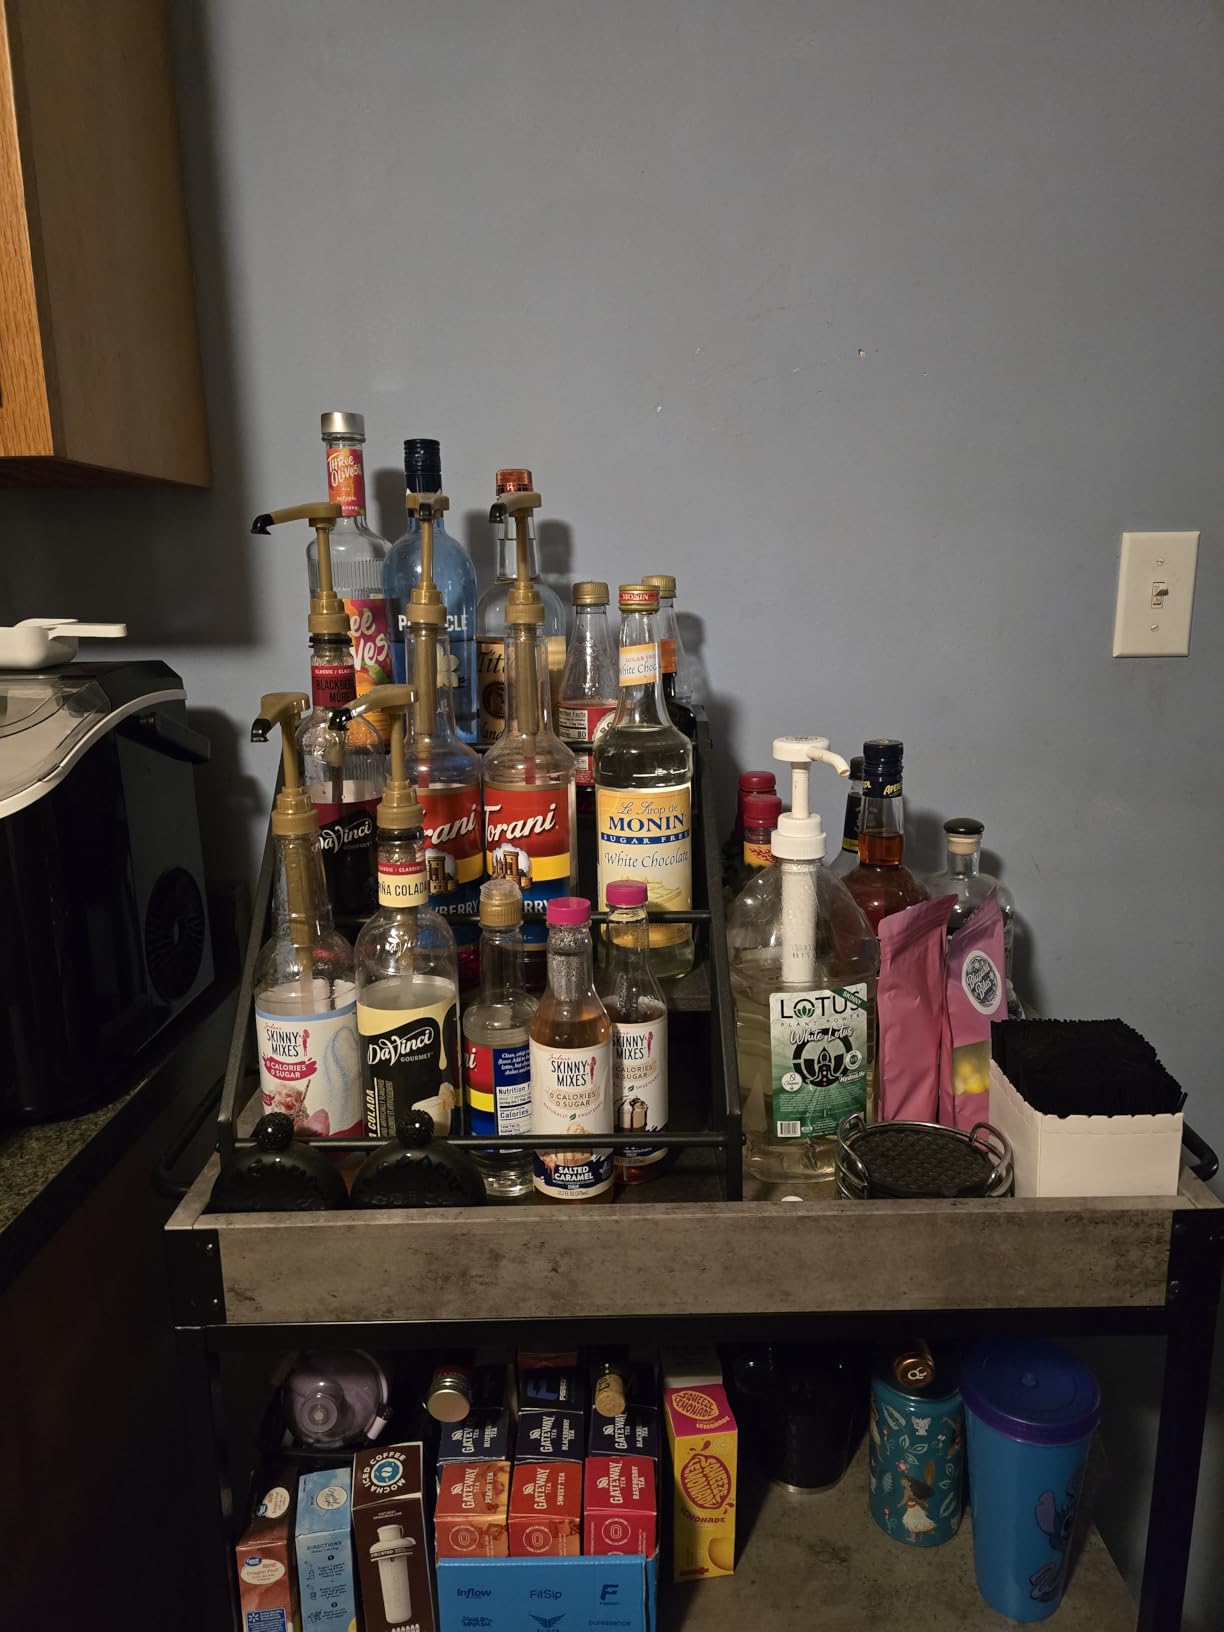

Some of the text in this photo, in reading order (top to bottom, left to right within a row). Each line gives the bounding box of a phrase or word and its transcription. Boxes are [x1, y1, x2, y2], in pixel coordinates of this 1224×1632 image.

[398, 614, 468, 632] PCLE
[477, 649, 504, 675] Tit
[637, 660, 657, 673] Choc
[883, 781, 904, 796] APER
[617, 801, 678, 816] Le Sirop de
[424, 803, 477, 845] rani
[484, 803, 557, 845] Torani
[608, 813, 686, 832] MONIN
[603, 831, 689, 844] SUGAR FREE
[605, 848, 688, 868] White Chocolate
[378, 877, 427, 897] IÑA COLADA
[435, 900, 480, 915] BERRY
[780, 990, 861, 1019] LOTUS
[842, 990, 863, 1005] SKINNY
[826, 1014, 860, 1024] POWER
[266, 1029, 299, 1045] SKINNY
[612, 1035, 645, 1048] SKINNY
[790, 1026, 854, 1045] White Lotus
[271, 1043, 299, 1057] MIXES
[367, 1026, 434, 1066] DaVinci
[616, 1047, 644, 1060] MIXES
[400, 1053, 431, 1063] GOURMET
[270, 1062, 307, 1071] CALORIES
[275, 1070, 301, 1078] SUGAR
[551, 1060, 587, 1074] SKINNY
[615, 1064, 653, 1073] CALORIES
[556, 1074, 587, 1087] MIXES
[621, 1072, 648, 1080] SUGAR
[498, 1086, 526, 1096] Nutrition
[556, 1092, 596, 1100] CALORIES
[367, 1089, 377, 1129] COLADA
[563, 1100, 591, 1108] SUGAR
[500, 1110, 529, 1119] Calories
[554, 1173, 594, 1181] CARAMEL
[558, 1165, 589, 1174] SALTED
[674, 1396, 714, 1418] LEMONADE
[677, 1392, 715, 1410] SQUEEZE
[539, 1415, 554, 1453] GATEWAY
[561, 1418, 570, 1451] BLACKBERRY
[370, 1451, 407, 1465] COFFEE
[362, 1466, 371, 1488] ICED
[609, 1461, 624, 1504] GATEWAY
[632, 1465, 640, 1500] RASPBERRY
[370, 1478, 406, 1494] MOCHA
[461, 1467, 479, 1509] GATEWAY
[485, 1471, 494, 1503] PEACH TEA
[534, 1467, 550, 1510] GATEWAY
[557, 1472, 565, 1506] SWEET TEA
[679, 1507, 726, 1523] LEMONADE
[306, 1541, 342, 1550] DIRECTIONS
[457, 1588, 492, 1599] Inflow
[530, 1589, 562, 1601] FitSip
